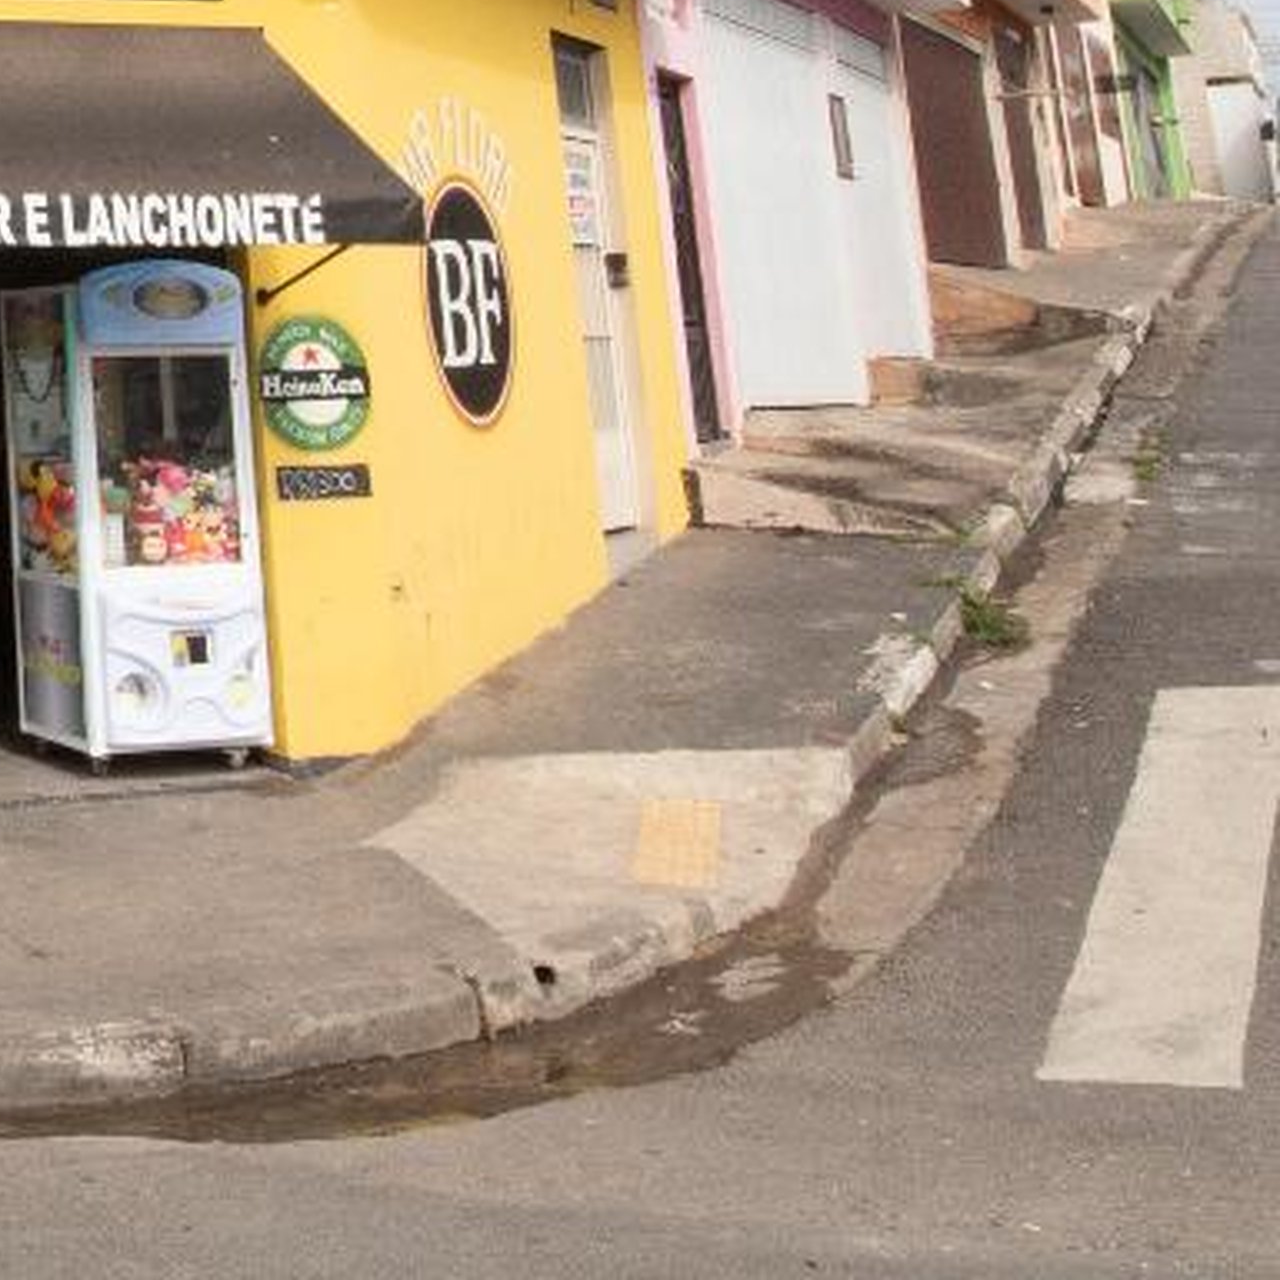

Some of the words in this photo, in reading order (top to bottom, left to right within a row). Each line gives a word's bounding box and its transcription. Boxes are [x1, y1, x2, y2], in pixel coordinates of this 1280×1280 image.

[22, 193, 54, 248] E
[59, 192, 326, 247] LANCHONETE
[429, 238, 503, 368] BF
